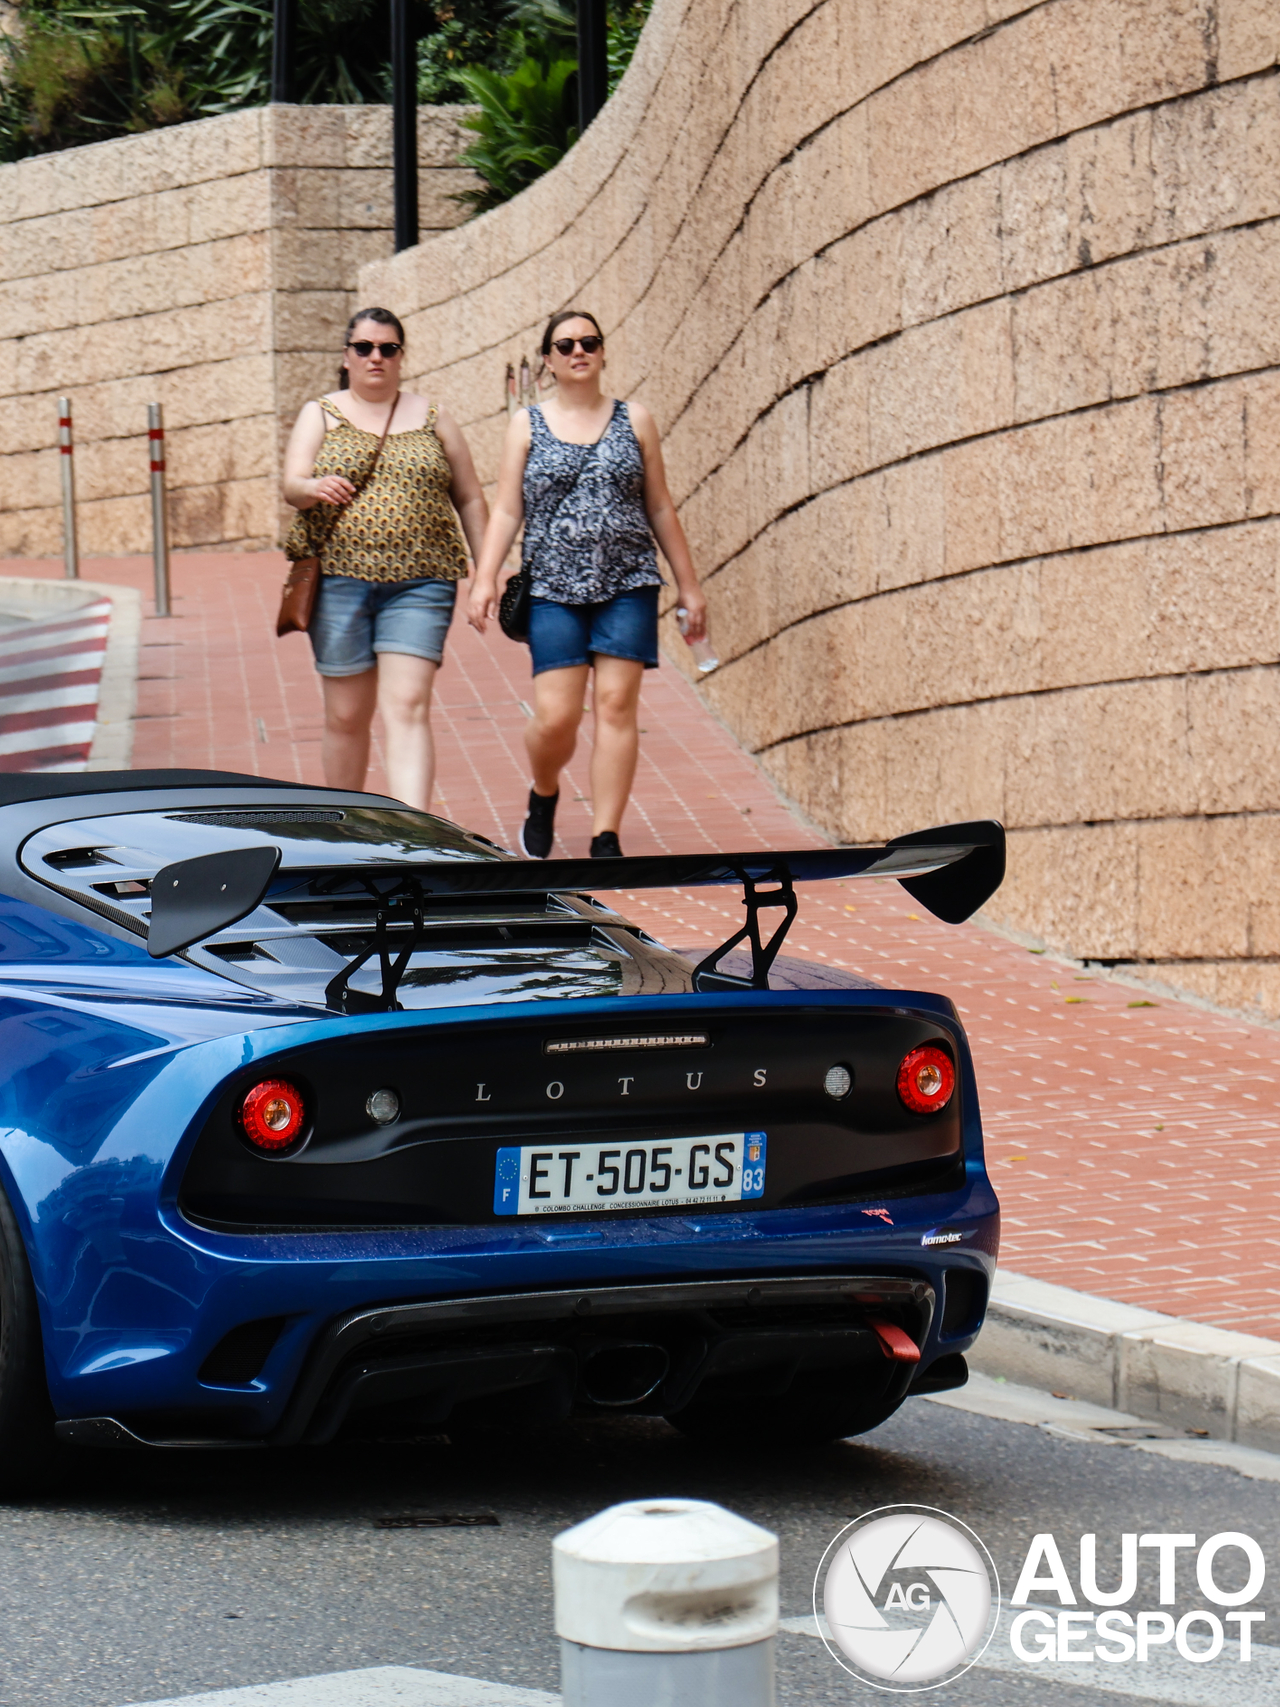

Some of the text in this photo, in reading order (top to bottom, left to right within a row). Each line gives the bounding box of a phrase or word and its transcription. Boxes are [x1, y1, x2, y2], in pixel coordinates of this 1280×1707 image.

[474, 1068, 768, 1102] LOTUS
[742, 1168, 764, 1192] 83
[502, 1188, 511, 1202] F
[572, 1203, 605, 1211] CHALLENGE
[609, 1200, 659, 1209] CONCESSIONNAIRE
[661, 1198, 680, 1206] LOTUS
